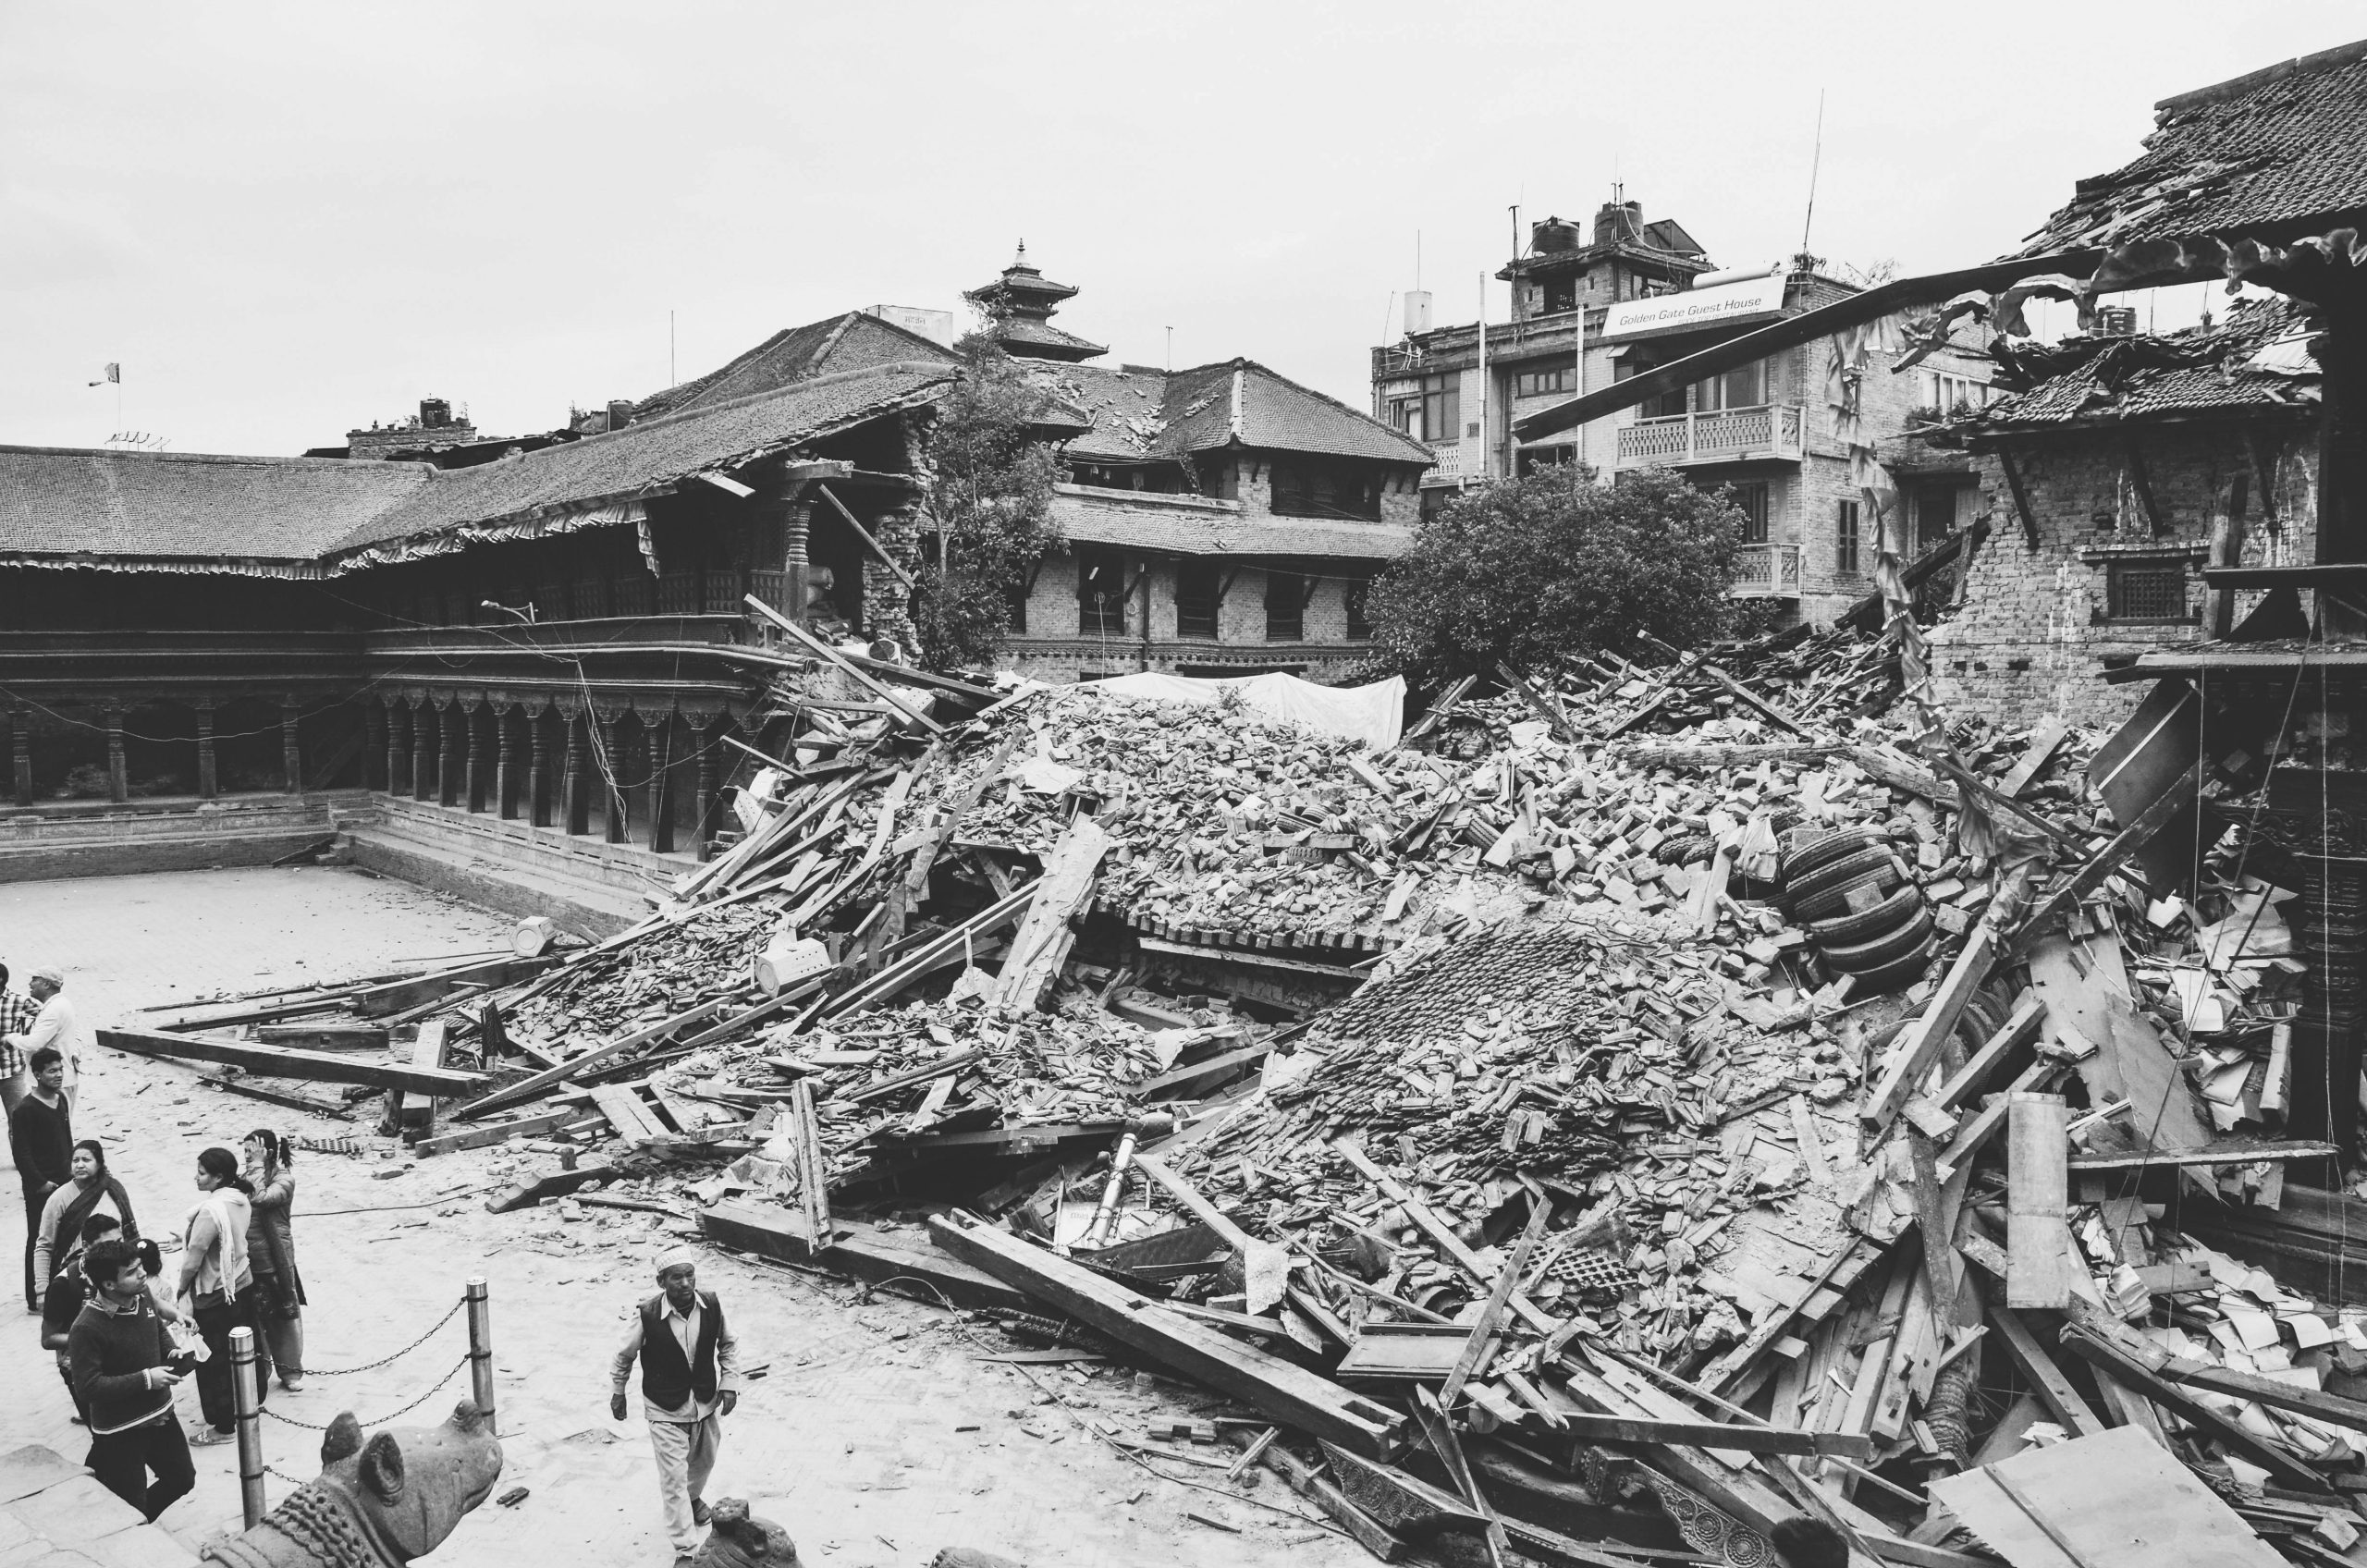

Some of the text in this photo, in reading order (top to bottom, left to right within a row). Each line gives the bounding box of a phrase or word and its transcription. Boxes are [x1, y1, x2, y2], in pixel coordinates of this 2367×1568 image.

[1619, 298, 1761, 326] Golden Gate Guest House
